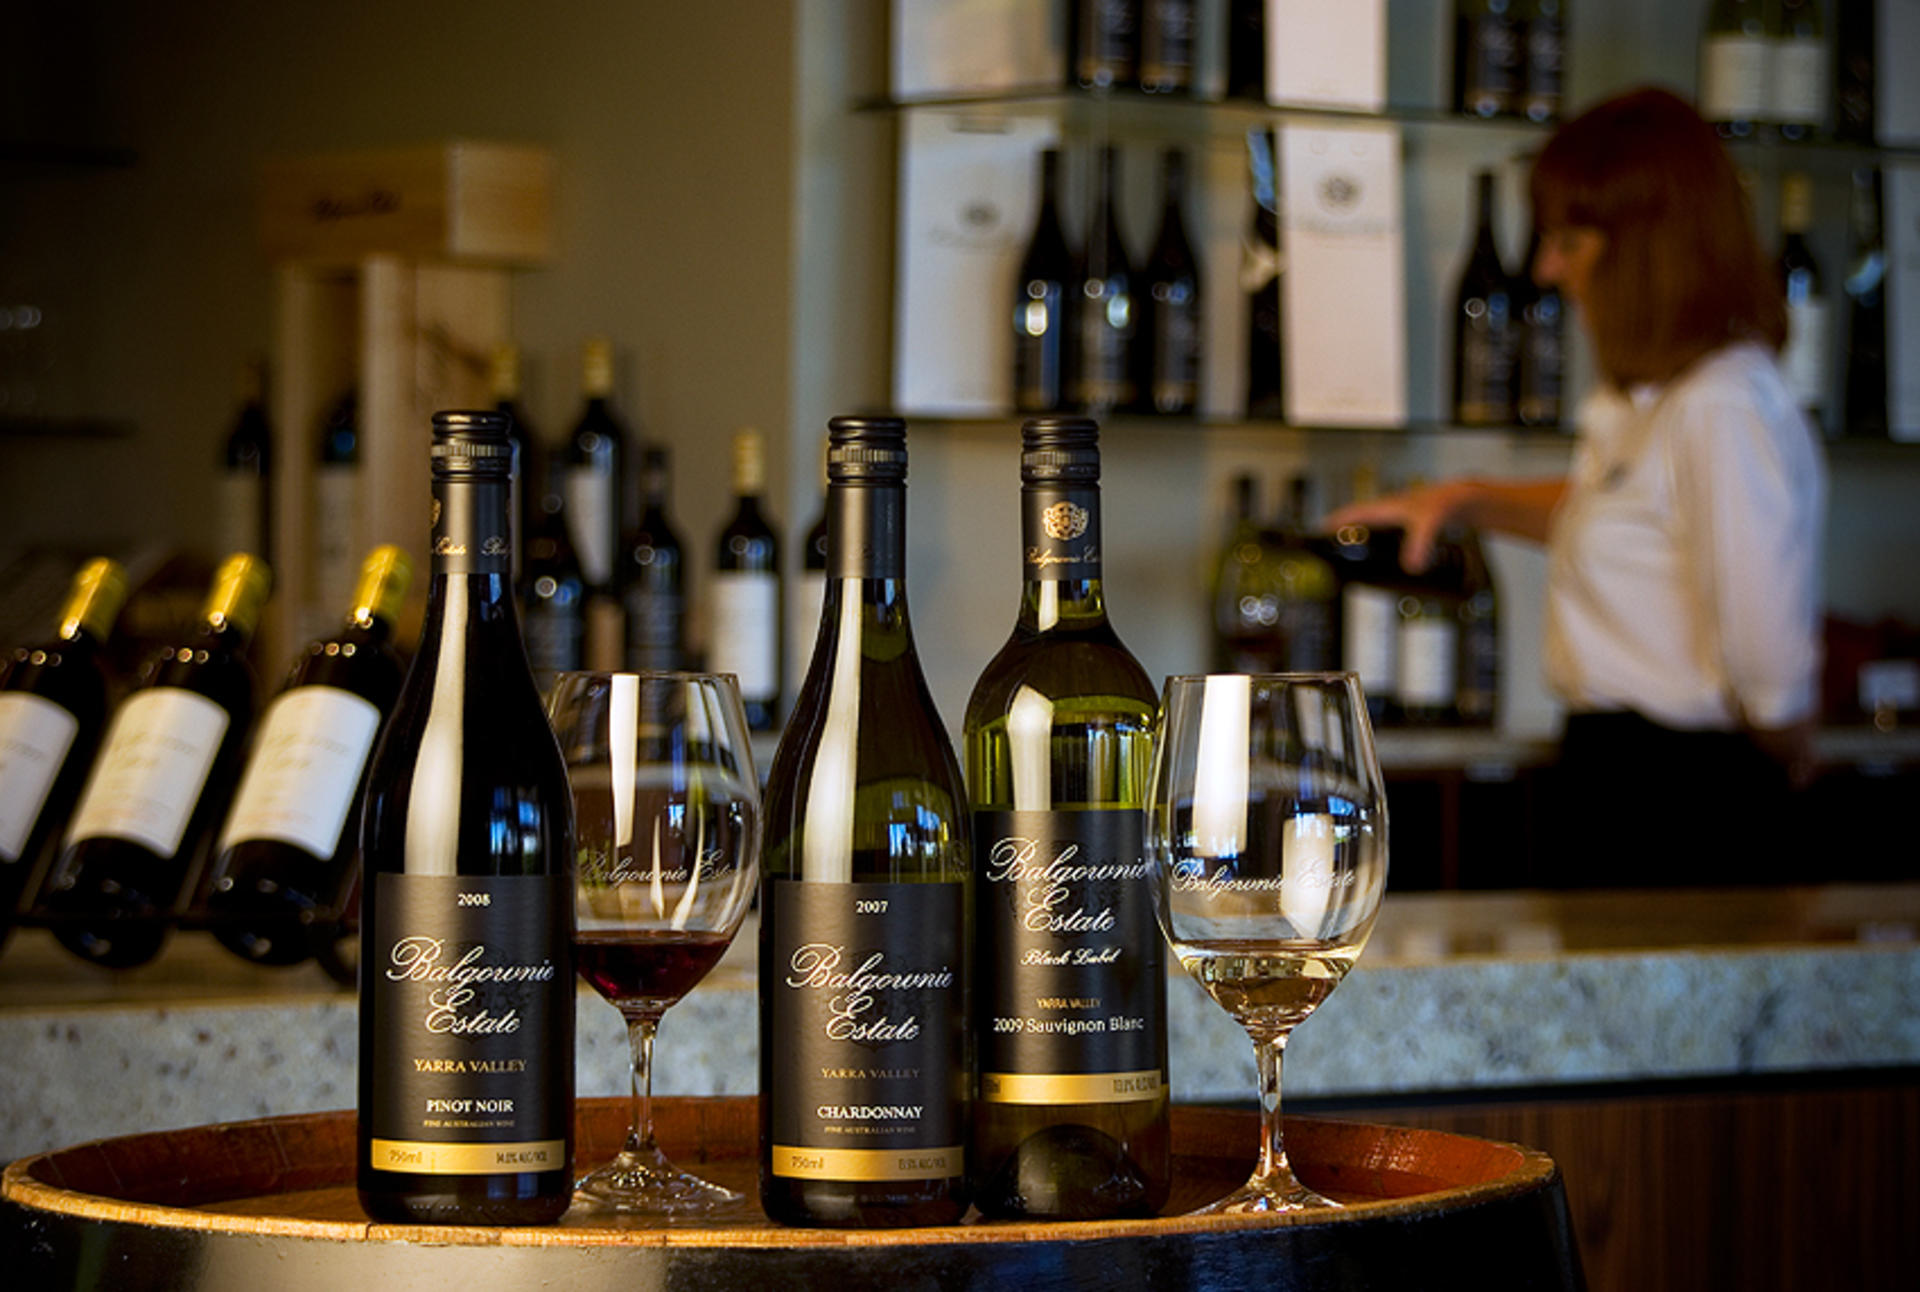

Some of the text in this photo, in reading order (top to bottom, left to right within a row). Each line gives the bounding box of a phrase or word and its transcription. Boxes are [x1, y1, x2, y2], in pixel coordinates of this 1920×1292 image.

[856, 900, 888, 913] 2007
[1025, 887, 1116, 932] Estate
[386, 936, 555, 995] Balgownie
[1020, 949, 1071, 966] Black
[785, 943, 953, 1001] Balgownie
[425, 988, 521, 1033] Estate
[826, 995, 920, 1040] Estate
[993, 1016, 1144, 1036] 2009 Sauvignon Blanc
[414, 1059, 527, 1073] YARRA VALLEY
[821, 1068, 920, 1079] YARRA VALLEY
[426, 1099, 514, 1113] PINOT NOIR
[816, 1106, 923, 1120] CHARDONNAY
